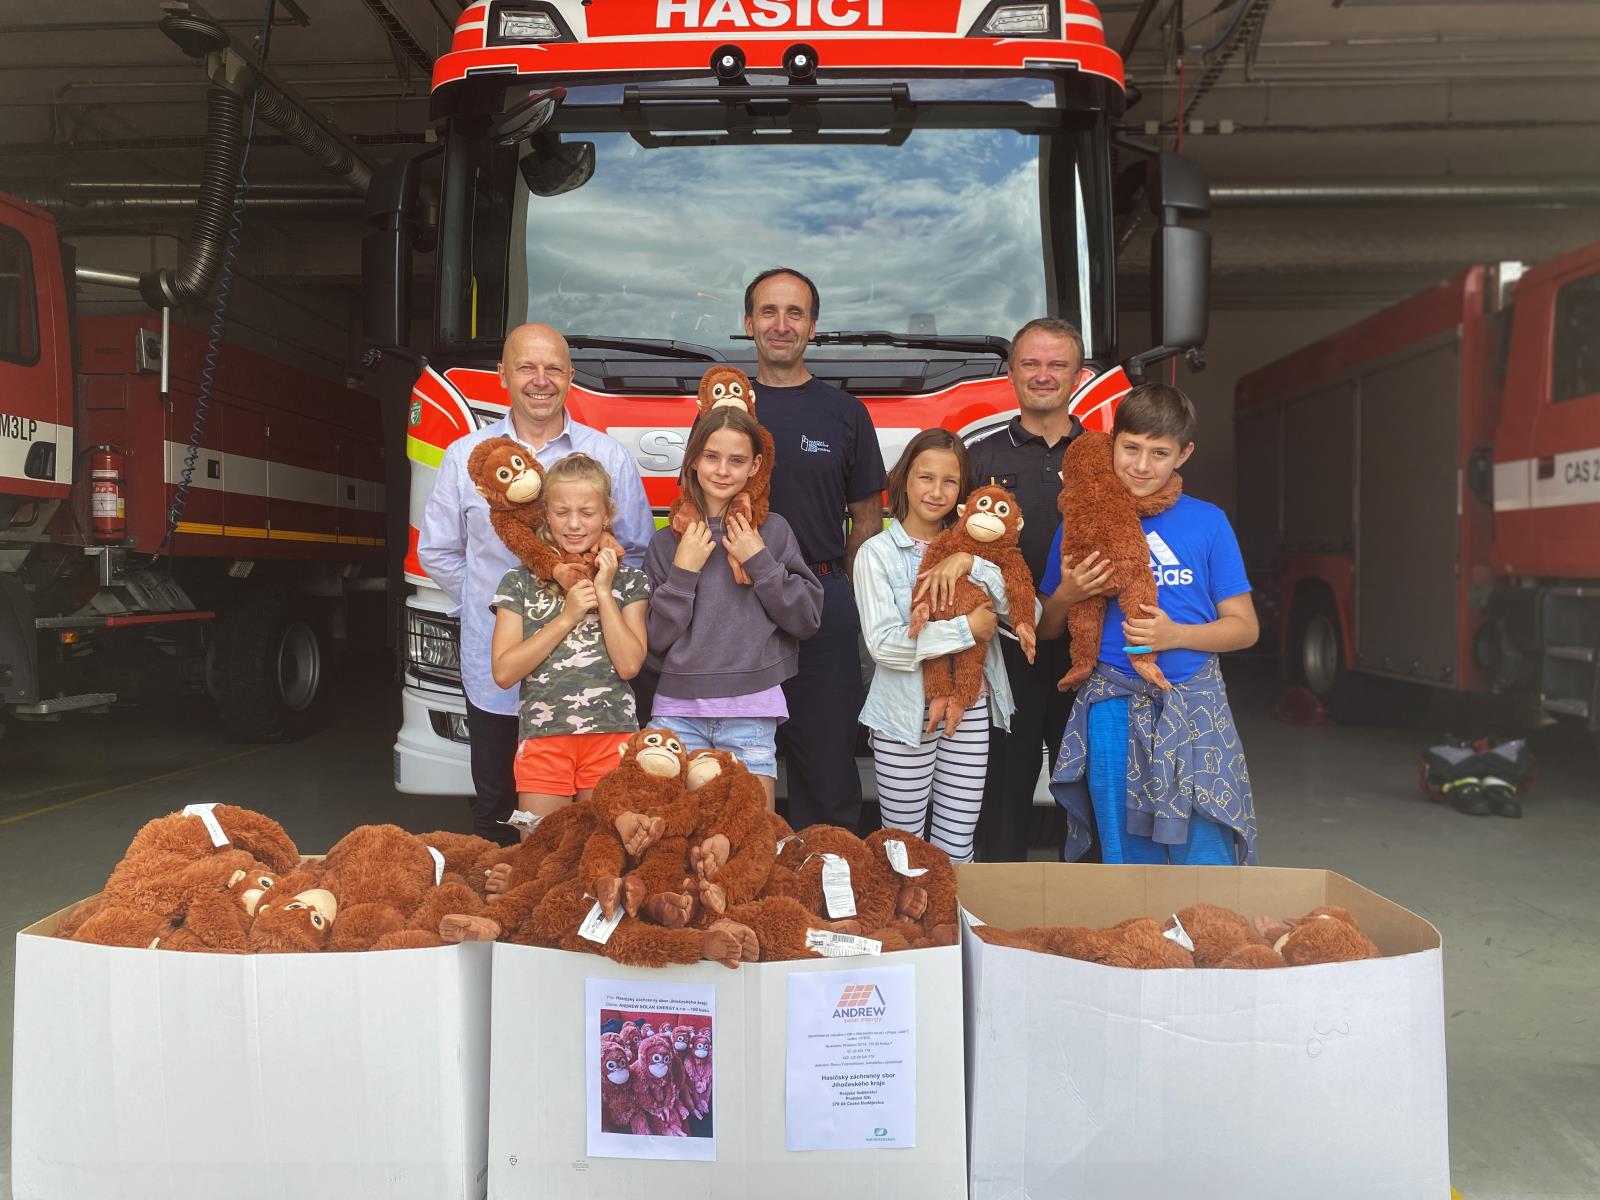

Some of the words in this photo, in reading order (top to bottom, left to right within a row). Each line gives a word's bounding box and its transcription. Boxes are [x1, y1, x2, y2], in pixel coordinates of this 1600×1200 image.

[0, 414, 37, 441] M3LP
[1564, 460, 1590, 484] CAS
[1153, 565, 1193, 586] das
[832, 1006, 886, 1018] ANDREW
